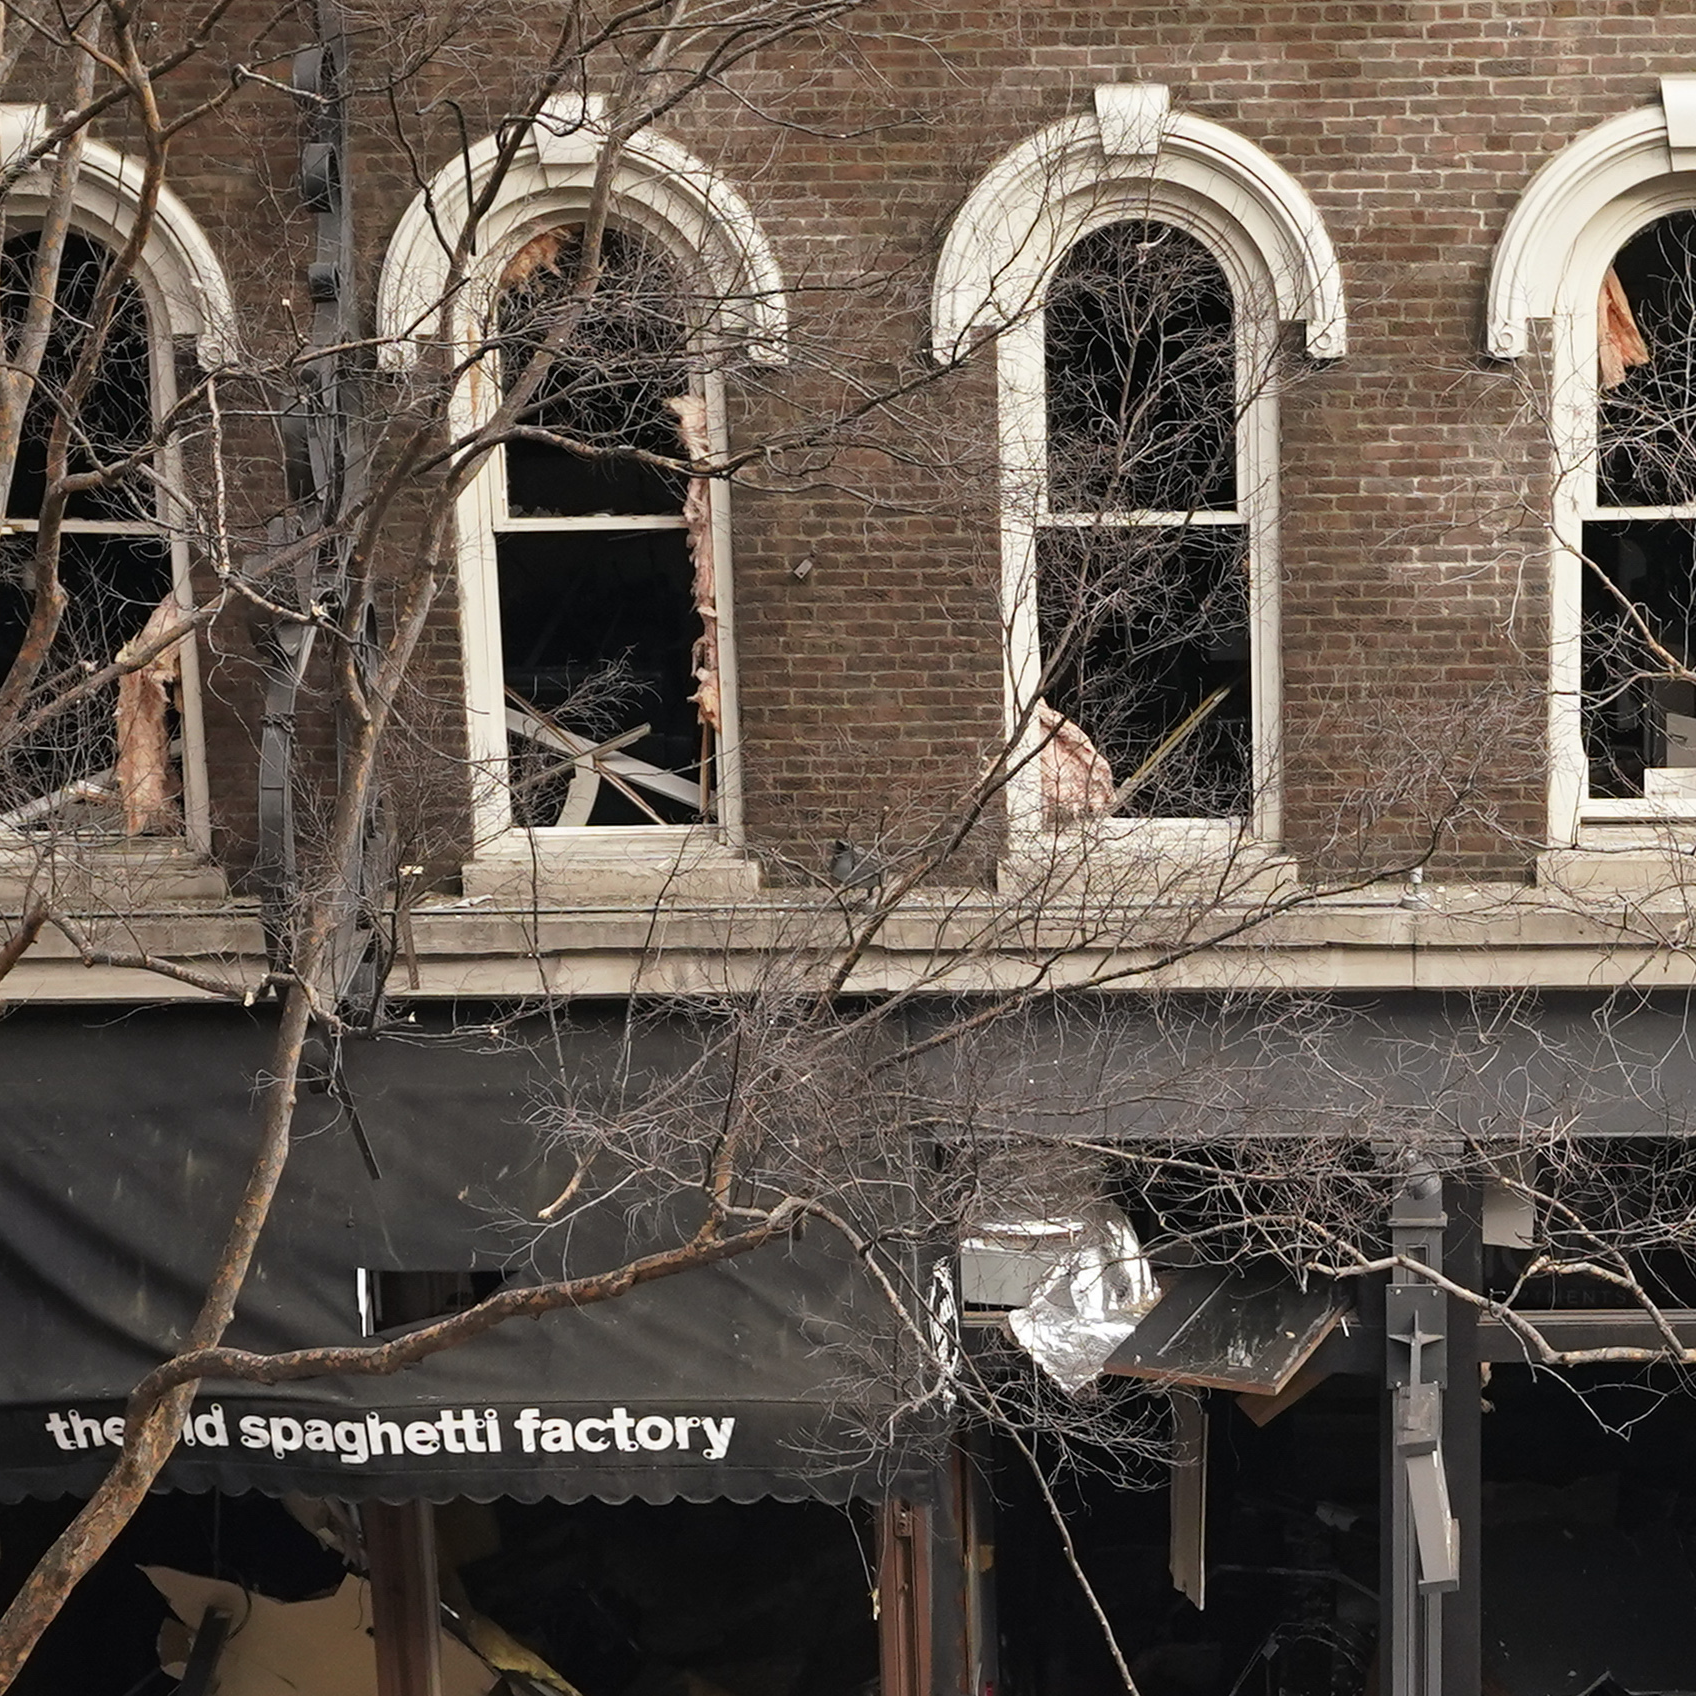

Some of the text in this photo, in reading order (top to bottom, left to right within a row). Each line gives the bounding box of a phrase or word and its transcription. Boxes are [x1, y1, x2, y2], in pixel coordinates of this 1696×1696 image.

[46, 1403, 735, 1464] the ld spaghetti factory
